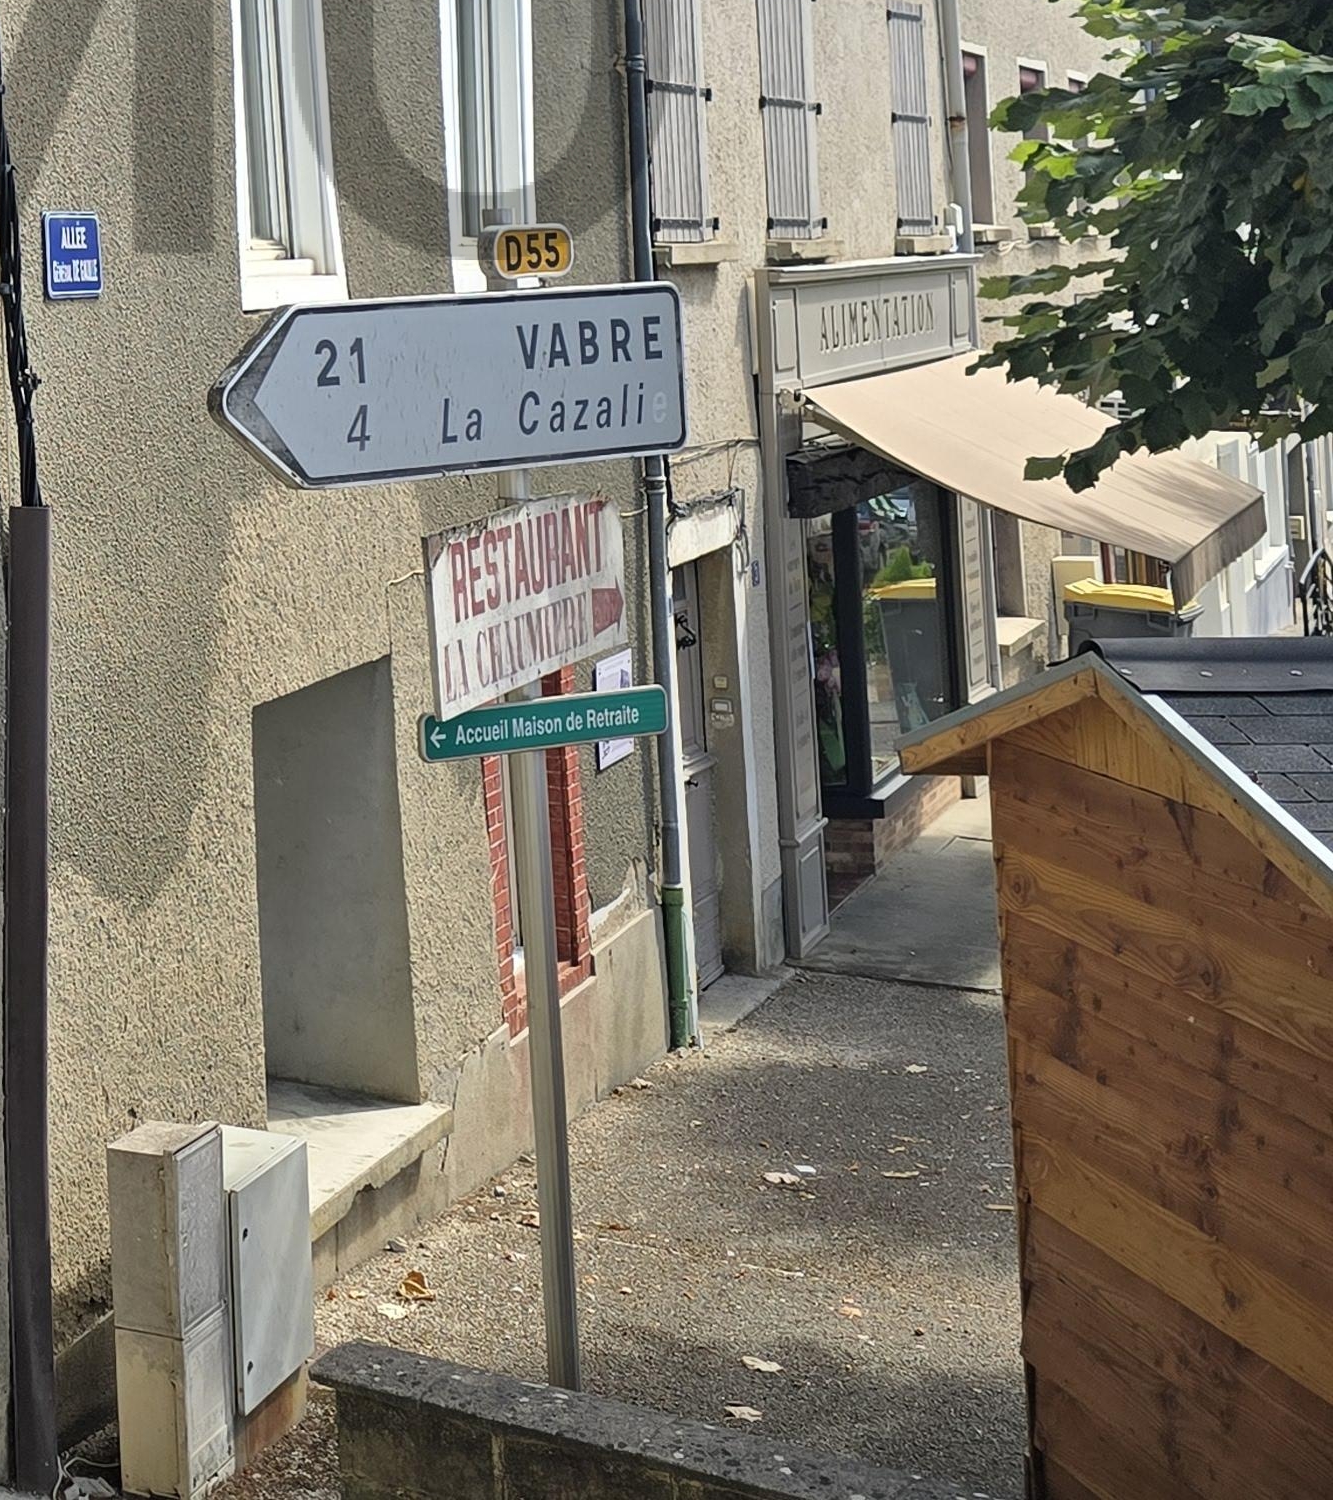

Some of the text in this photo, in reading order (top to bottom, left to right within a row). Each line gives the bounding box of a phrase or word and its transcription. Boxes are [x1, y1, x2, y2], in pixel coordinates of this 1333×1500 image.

[60, 220, 88, 250] ALLÉE
[505, 232, 560, 272] D55
[820, 292, 935, 352] ALIMENTATION
[314, 315, 663, 388] 21 VABRE
[346, 404, 371, 452] 4
[442, 397, 482, 445] La
[450, 500, 605, 623] RESTAURANT
[444, 639, 470, 704] LA
[455, 704, 640, 746] Accueil Maison de Retraite
